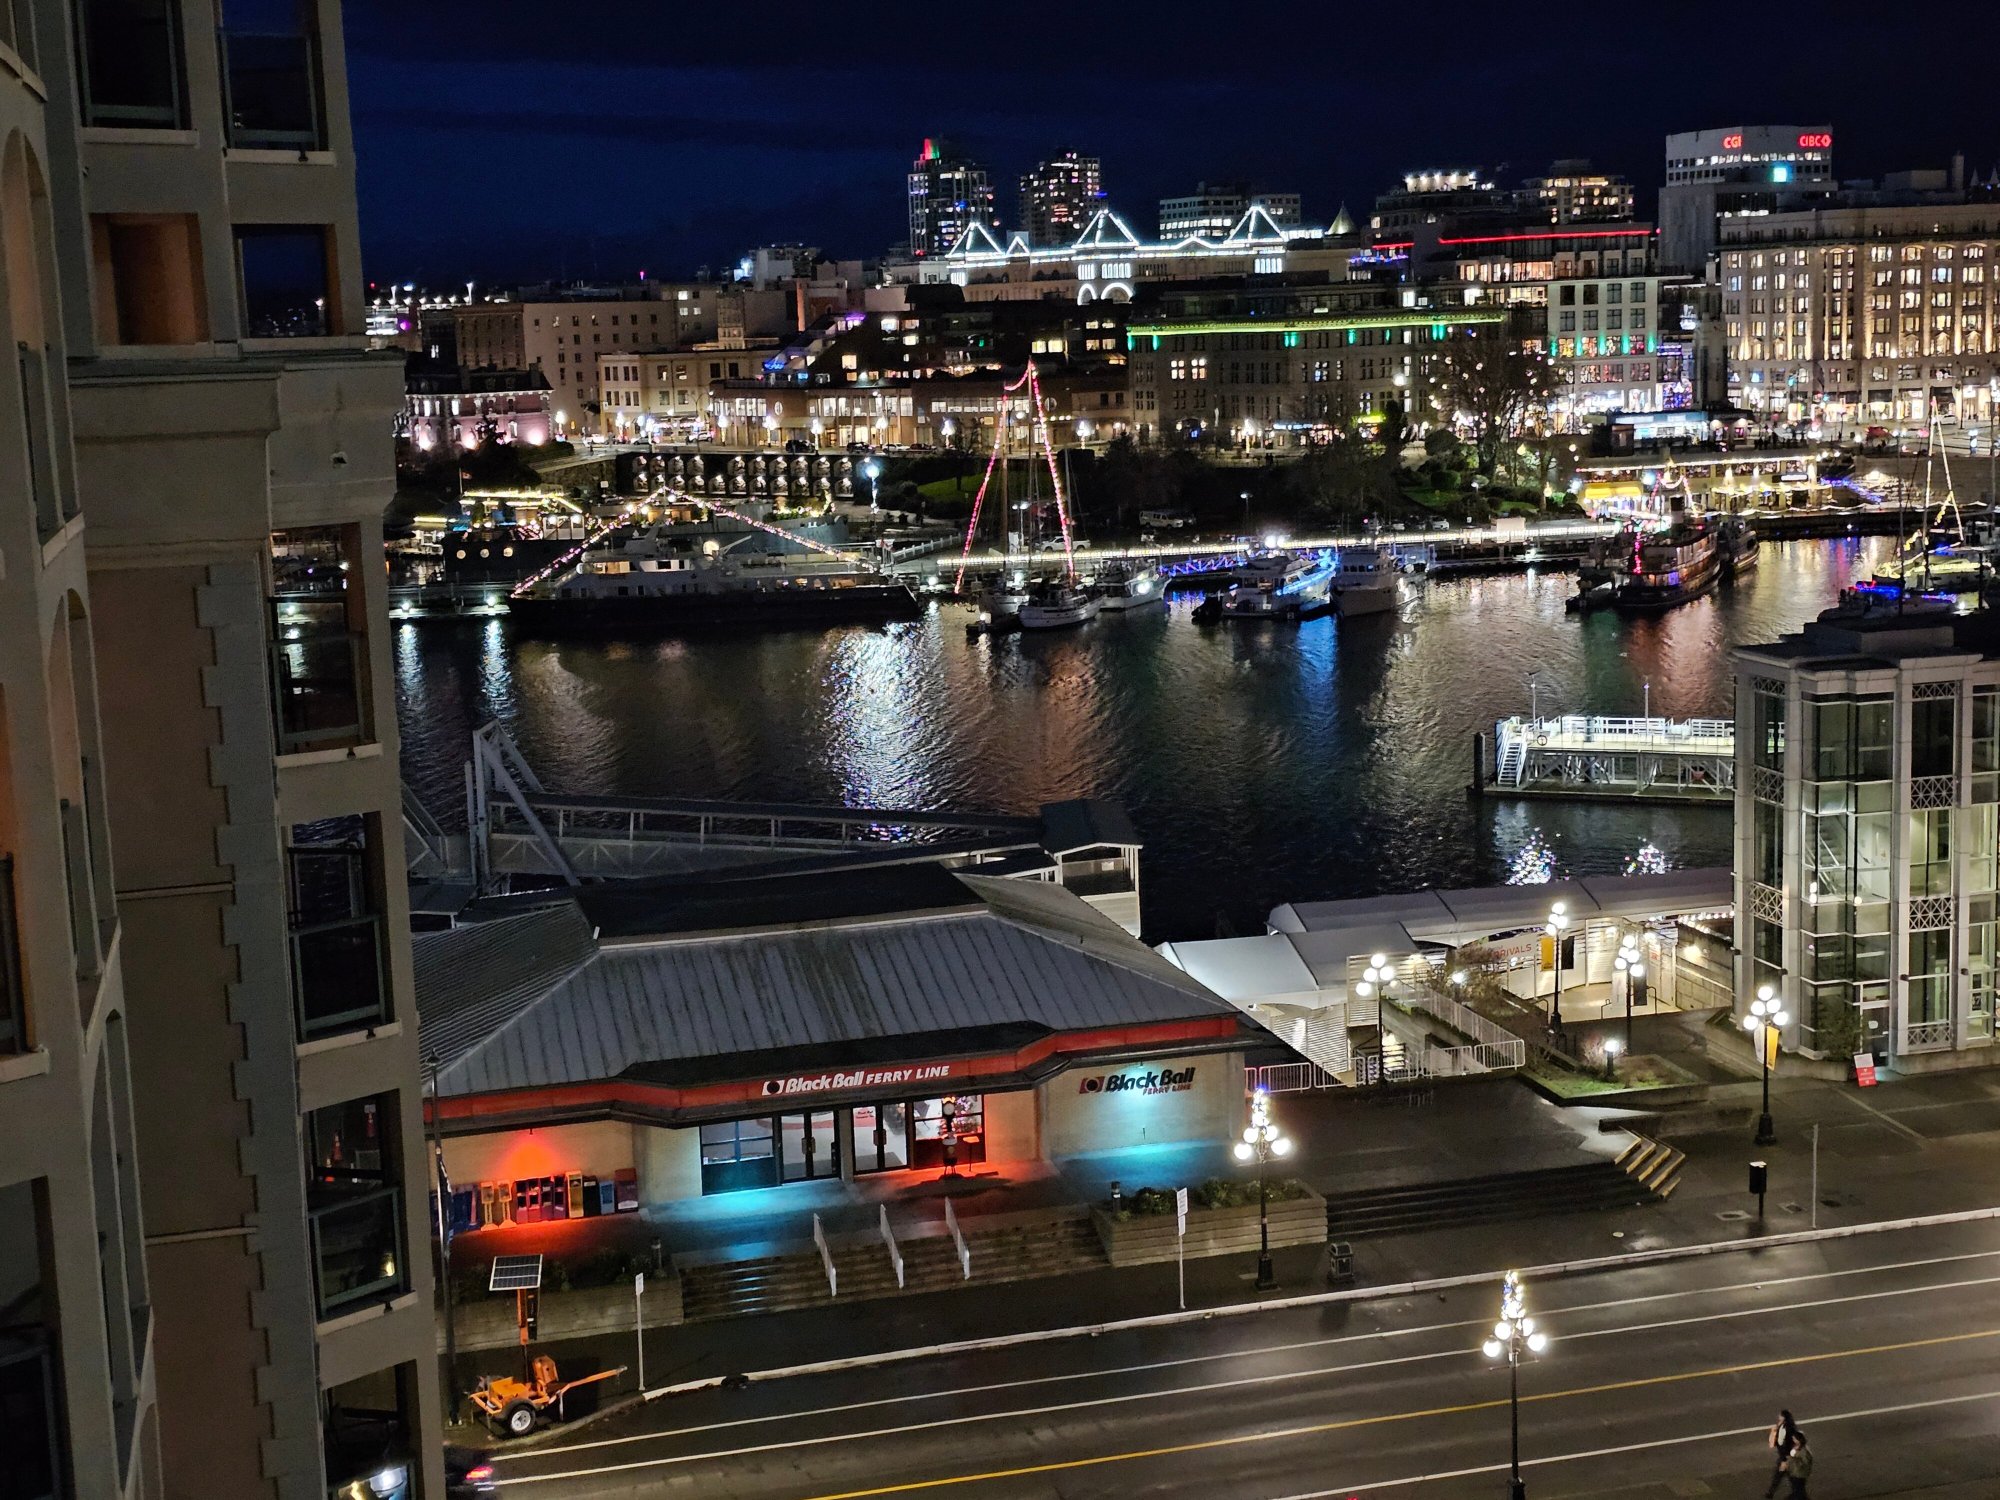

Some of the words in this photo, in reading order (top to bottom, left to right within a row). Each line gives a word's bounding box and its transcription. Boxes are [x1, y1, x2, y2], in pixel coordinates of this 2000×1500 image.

[1723, 136, 1742, 148] CGI
[1799, 135, 1821, 147] CIBC
[786, 1076, 832, 1093] Black
[832, 1071, 864, 1088] Ball
[866, 1069, 912, 1084] FERRY
[916, 1066, 950, 1079] LINE
[1106, 1072, 1159, 1092] Black
[1159, 1067, 1195, 1086] Ball
[1142, 1086, 1168, 1095] FERRY
[1172, 1084, 1192, 1092] LINE
